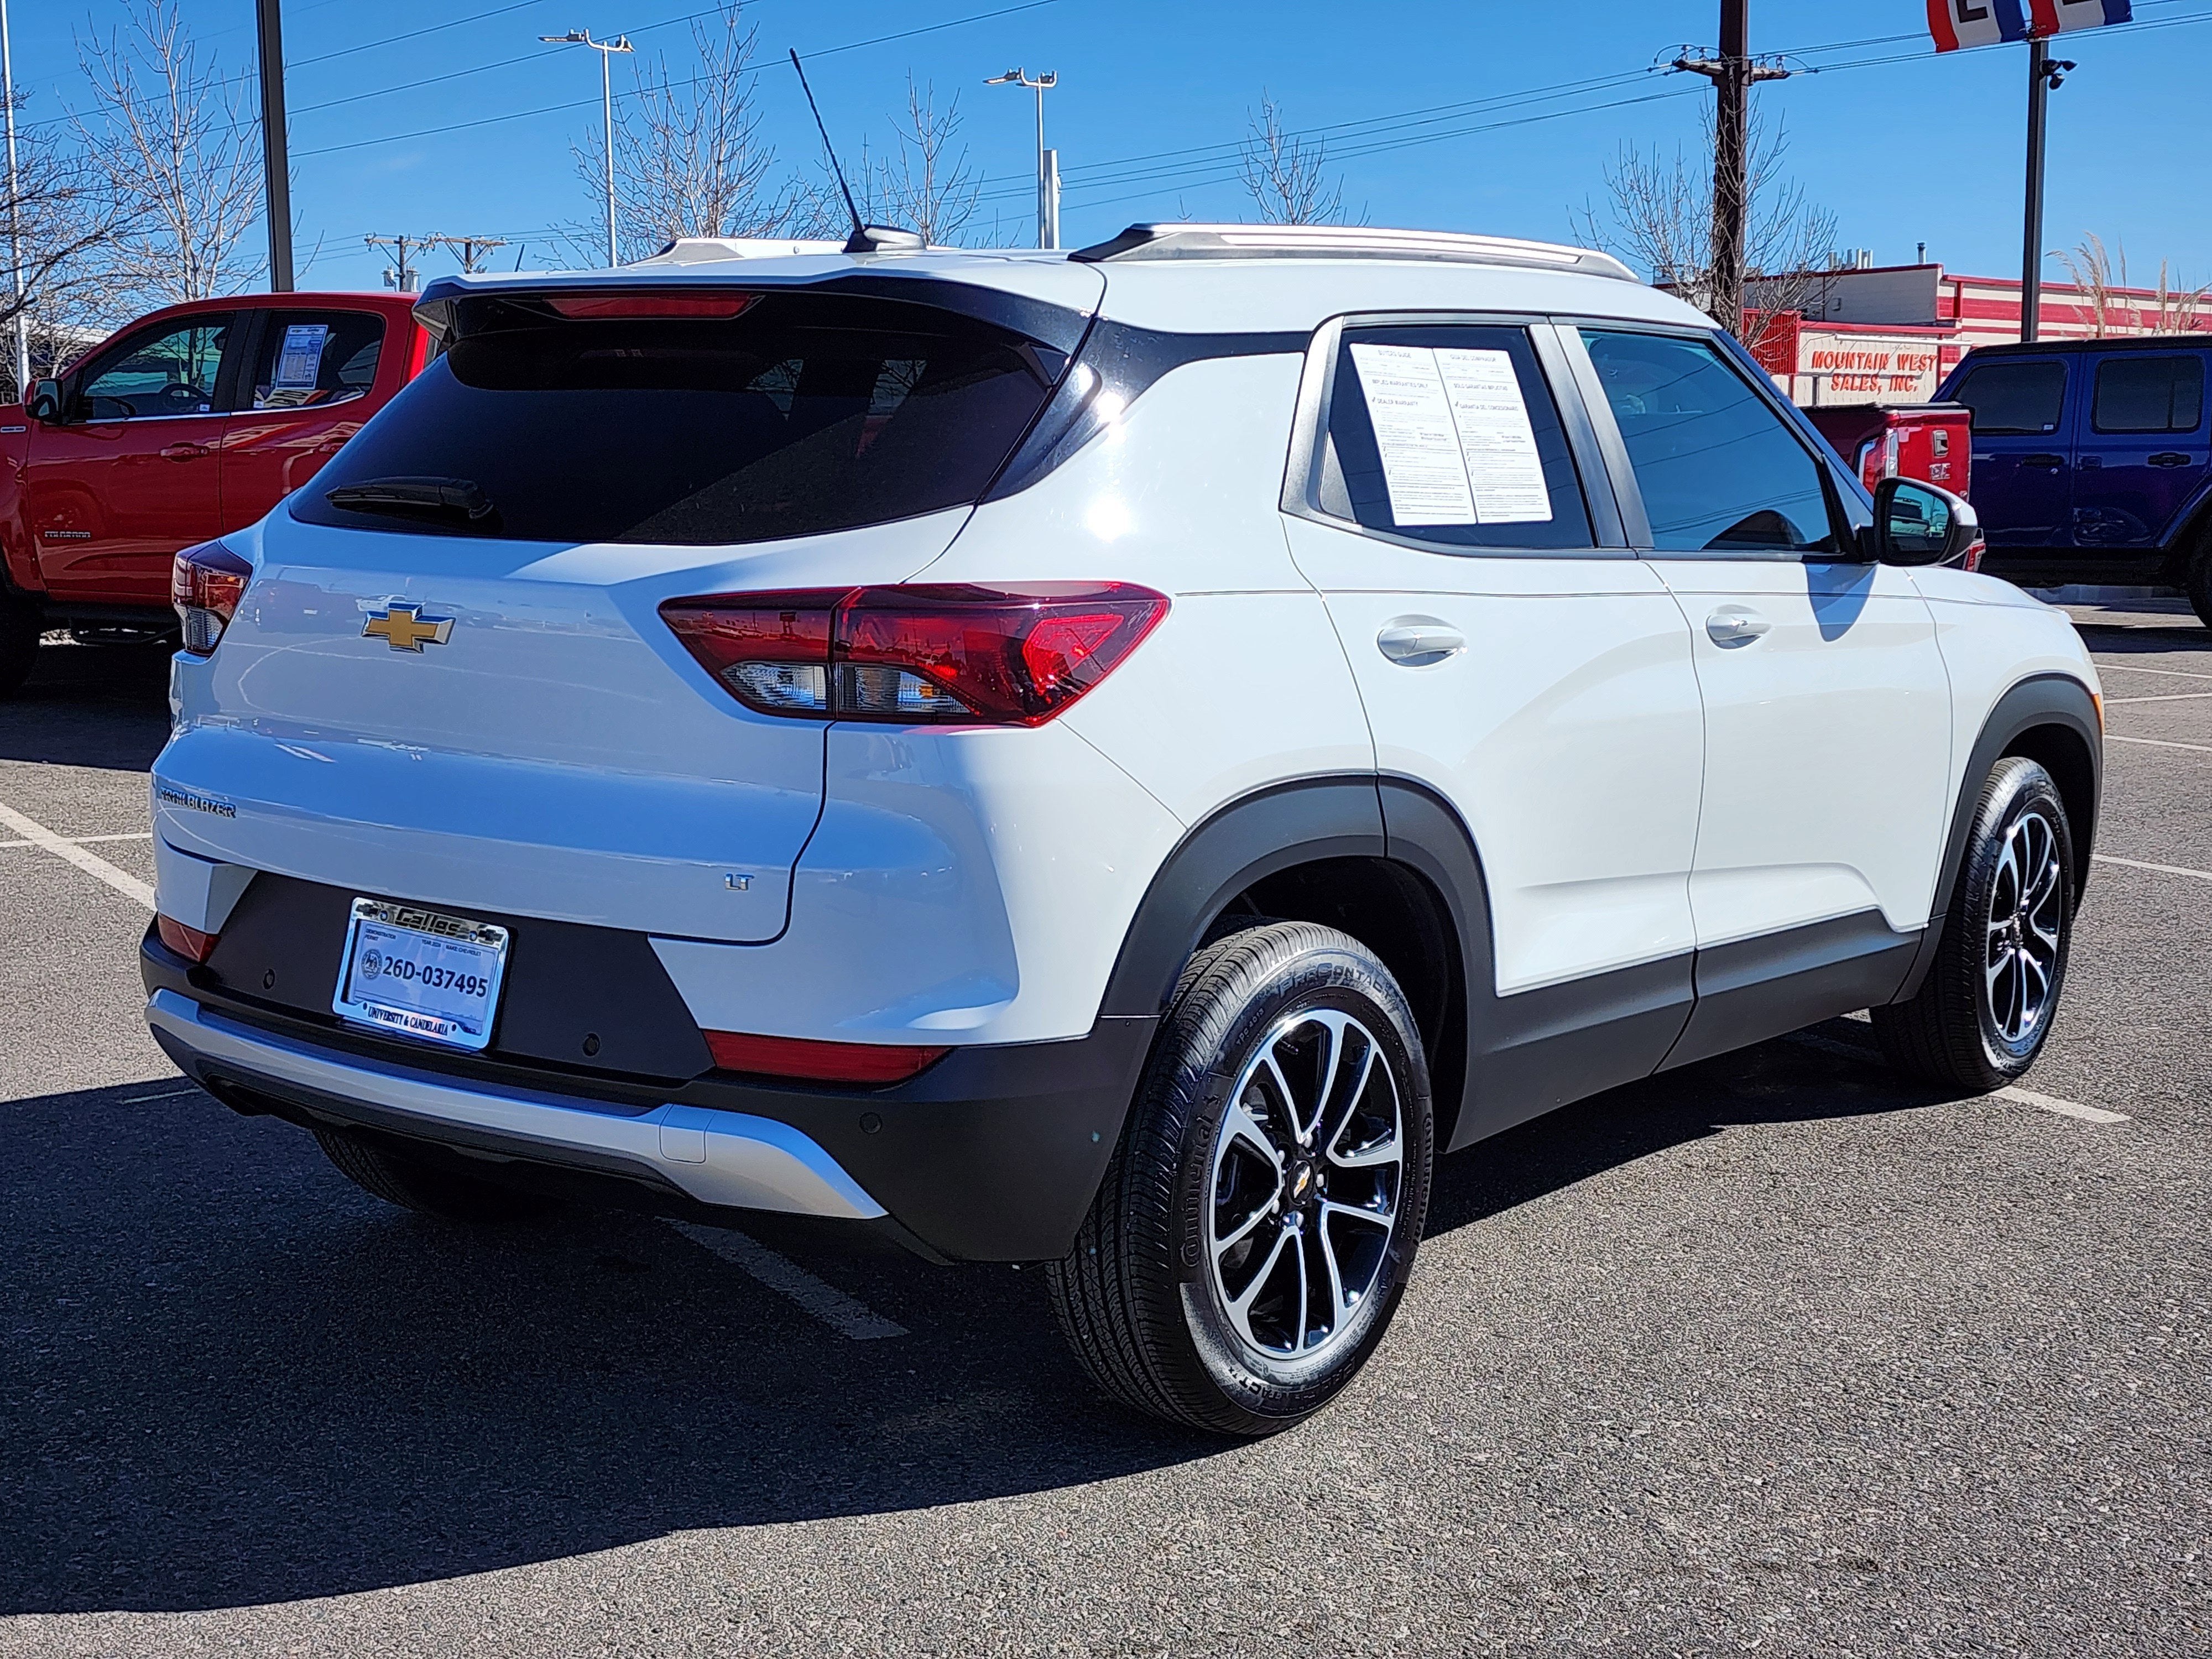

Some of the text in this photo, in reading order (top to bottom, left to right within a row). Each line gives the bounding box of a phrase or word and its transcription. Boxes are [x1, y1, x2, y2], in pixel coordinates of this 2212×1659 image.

[1811, 351, 1938, 372] MOUNTAIN WEST
[1830, 373, 1918, 396] SALES, INC.
[160, 786, 237, 818] TRAILBLAZER
[725, 873, 755, 891] LT
[383, 956, 488, 998] 26D-037495
[368, 1006, 404, 1025] UNIVERSITY
[410, 1016, 448, 1036] CANDELARIA
